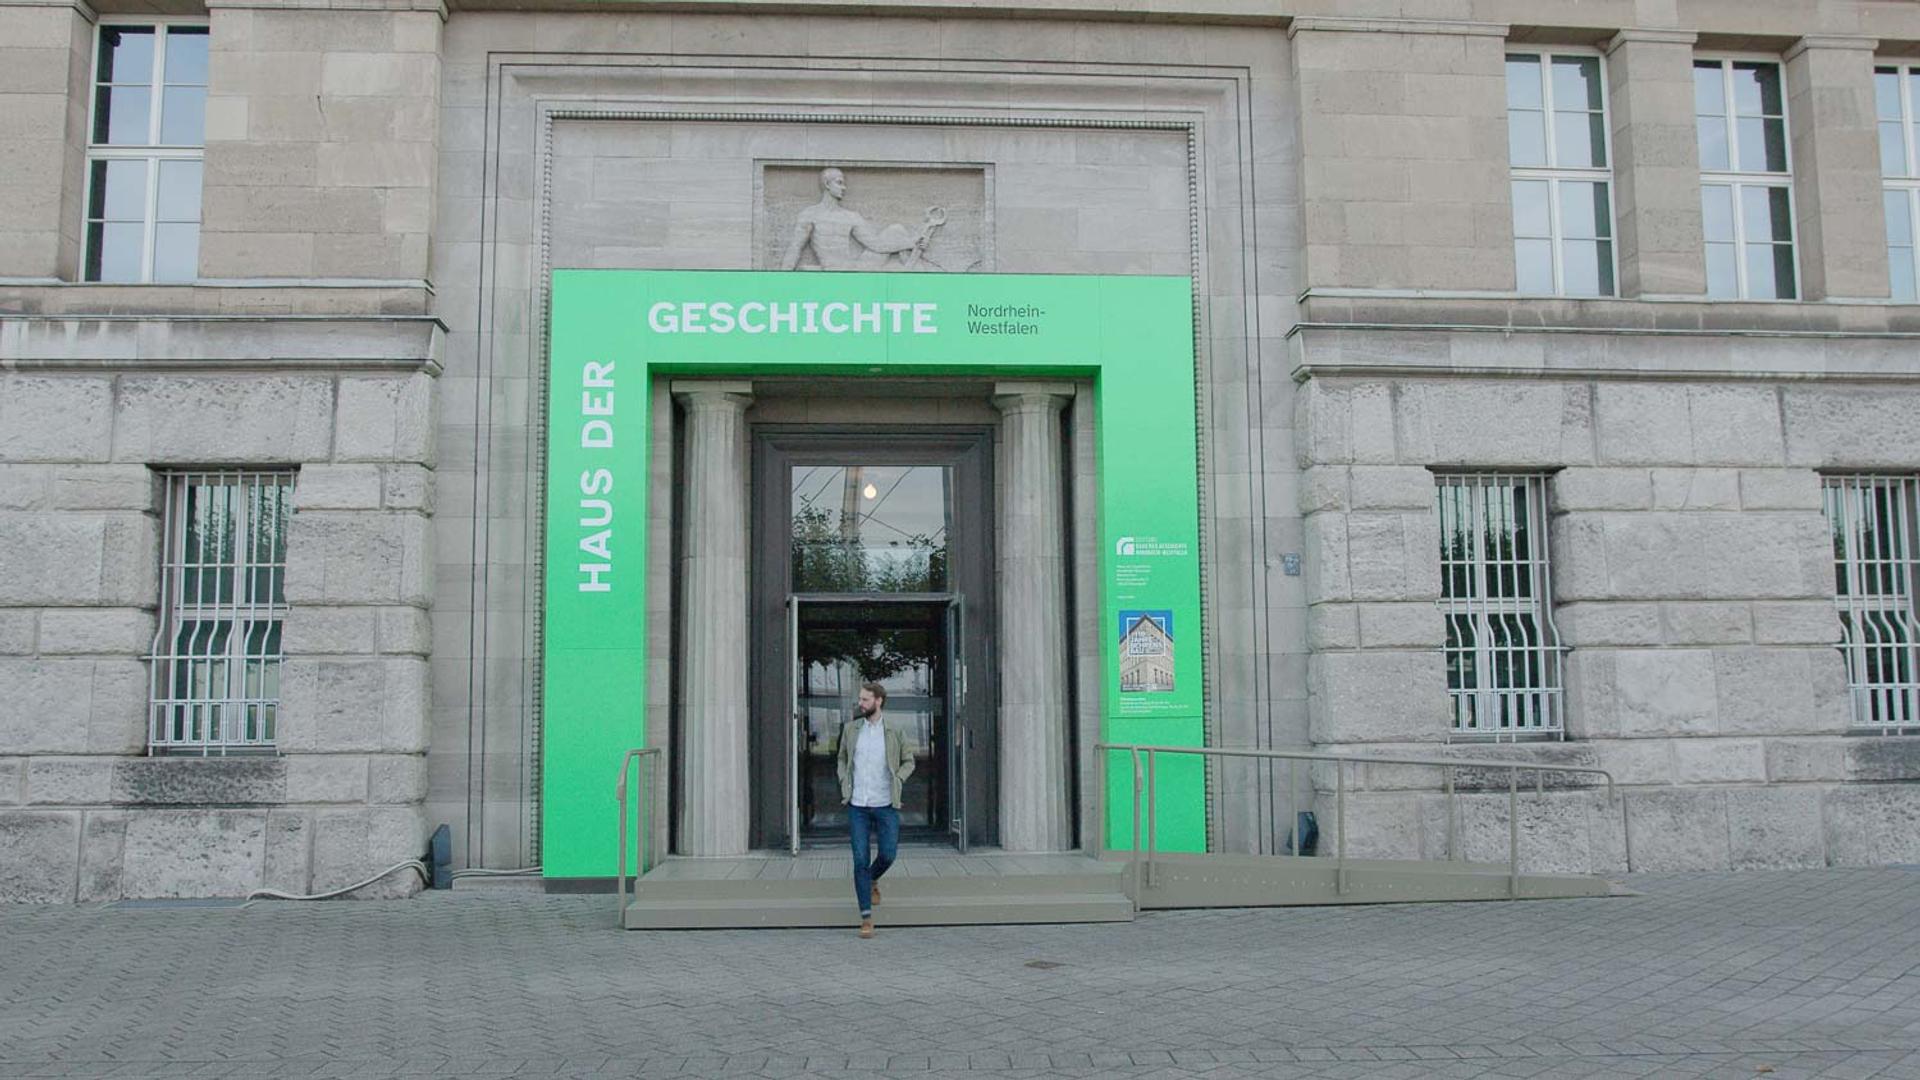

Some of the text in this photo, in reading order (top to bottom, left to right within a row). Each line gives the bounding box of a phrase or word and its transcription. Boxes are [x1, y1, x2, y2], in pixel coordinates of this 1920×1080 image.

[648, 301, 938, 334] GESCHICHTE
[967, 303, 1046, 318] Nordrhein-
[967, 320, 1039, 335] Westfalen
[578, 360, 615, 593] HAUS DER
